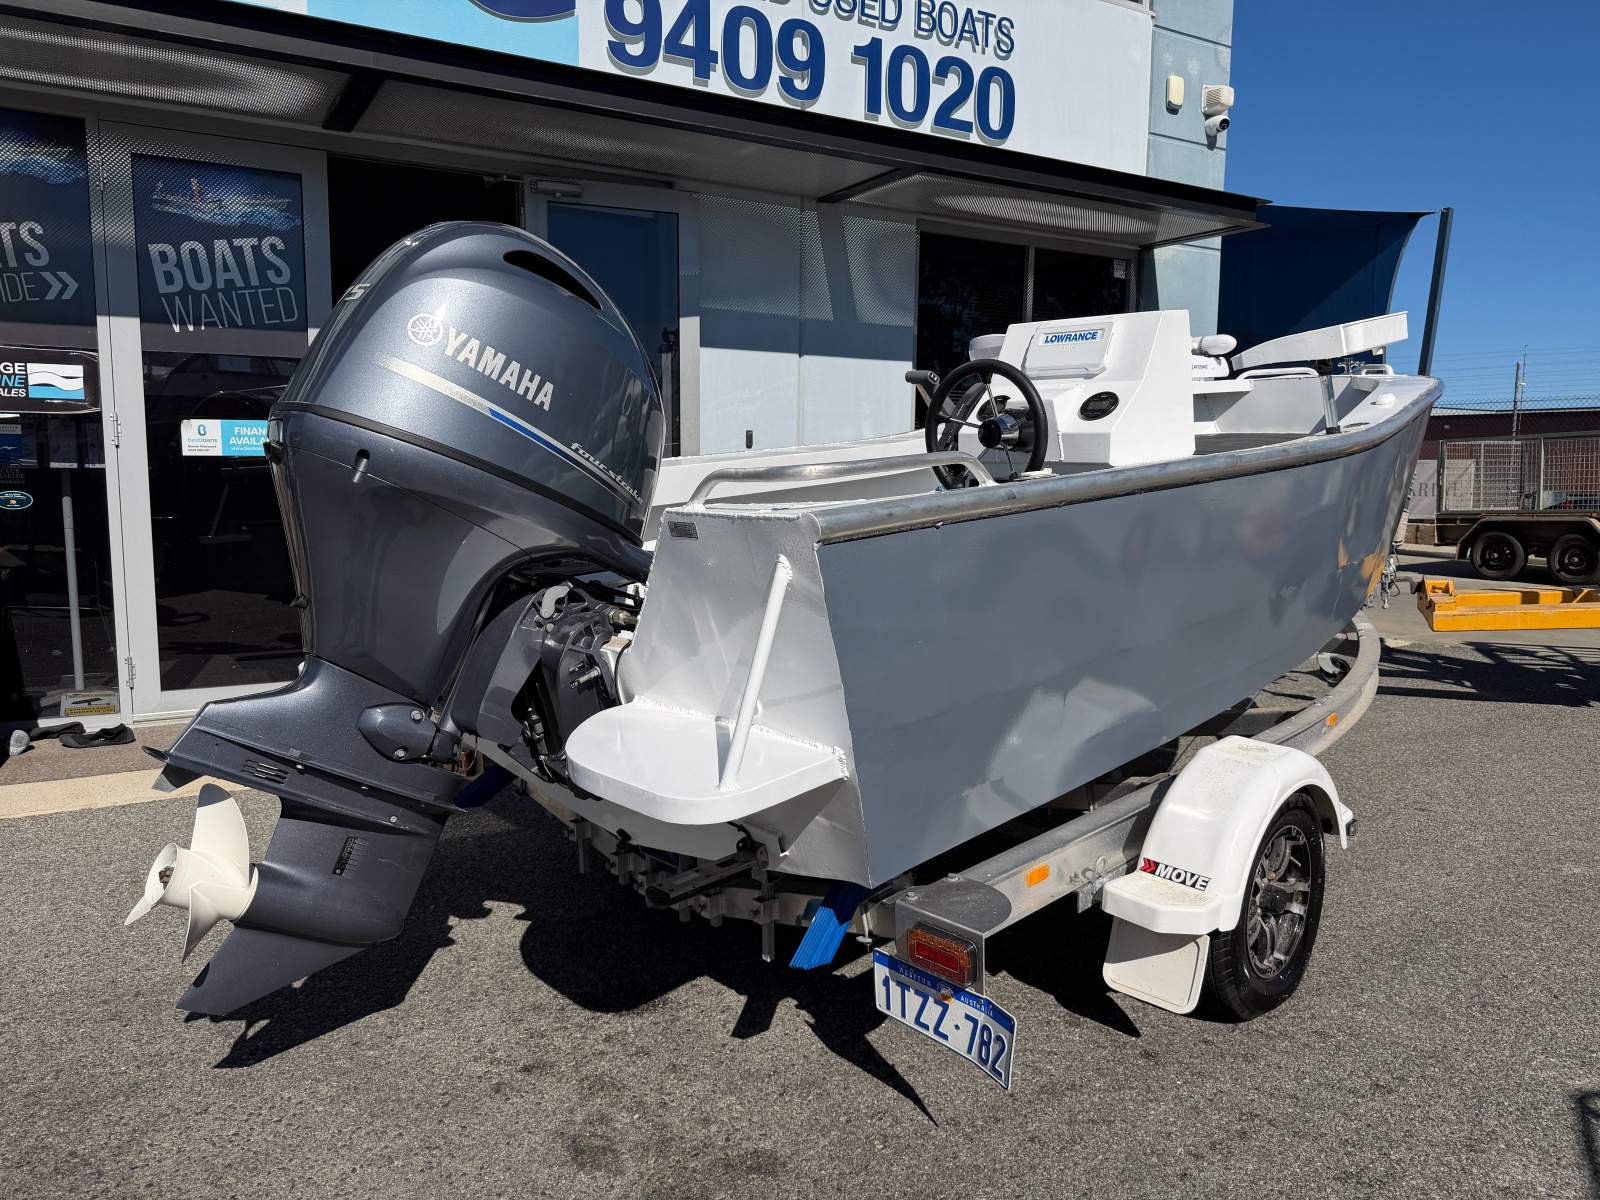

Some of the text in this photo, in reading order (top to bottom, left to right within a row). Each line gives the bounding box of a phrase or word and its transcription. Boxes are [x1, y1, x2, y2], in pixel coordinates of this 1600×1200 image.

[915, 0, 1015, 56] BOATS
[604, 0, 1016, 142] 9409 1020
[0, 221, 50, 268] TS
[148, 236, 291, 294] BOATS
[160, 286, 298, 333] WANTED
[1044, 331, 1098, 344] LOWRANCE
[444, 327, 556, 412] YAMAHA
[234, 426, 268, 436] FINAN
[1154, 863, 1209, 891] MOVE
[960, 995, 993, 1016] AUSTRALIA
